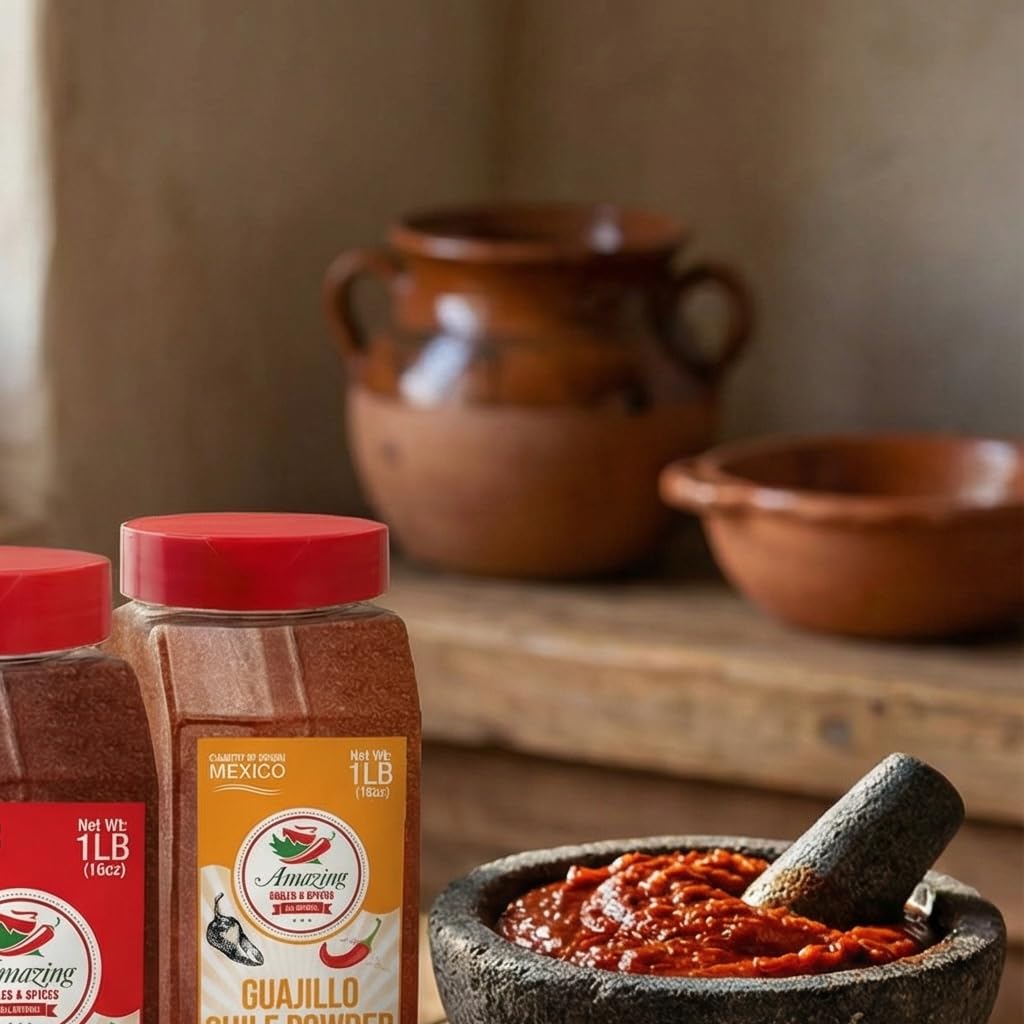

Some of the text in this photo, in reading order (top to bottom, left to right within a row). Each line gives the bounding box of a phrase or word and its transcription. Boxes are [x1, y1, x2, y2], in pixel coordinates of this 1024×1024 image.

[209, 763, 286, 779] MEXICO
[349, 761, 393, 785] 1LB
[78, 818, 100, 832] Net
[76, 833, 130, 862] 1LB
[254, 866, 349, 890] Amazing
[241, 976, 359, 1010] GUAJILLO
